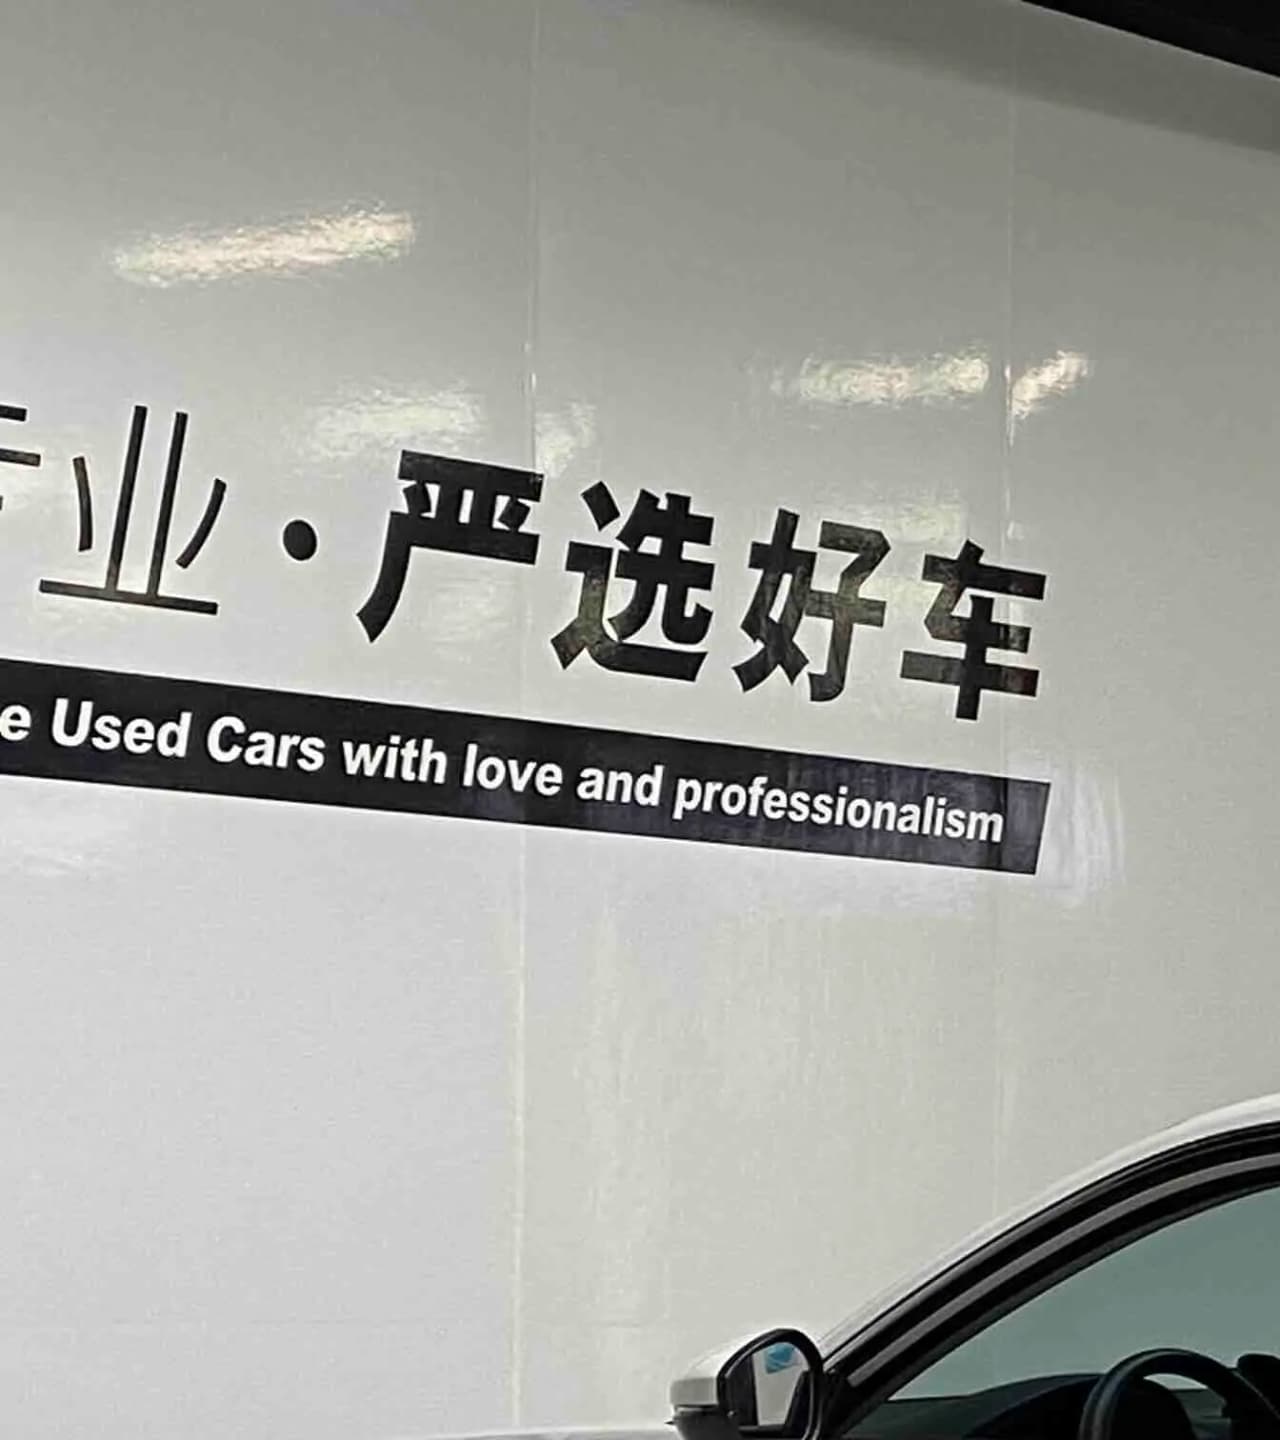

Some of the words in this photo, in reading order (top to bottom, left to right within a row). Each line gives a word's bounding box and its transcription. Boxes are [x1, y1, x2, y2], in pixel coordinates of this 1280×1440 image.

[0, 406, 1047, 721] 业·严选好车
[51, 698, 192, 758] Used
[206, 713, 326, 773] Cars
[341, 732, 448, 786] with
[463, 743, 564, 797] love
[576, 759, 662, 808] and
[672, 776, 1005, 845] professionalism
